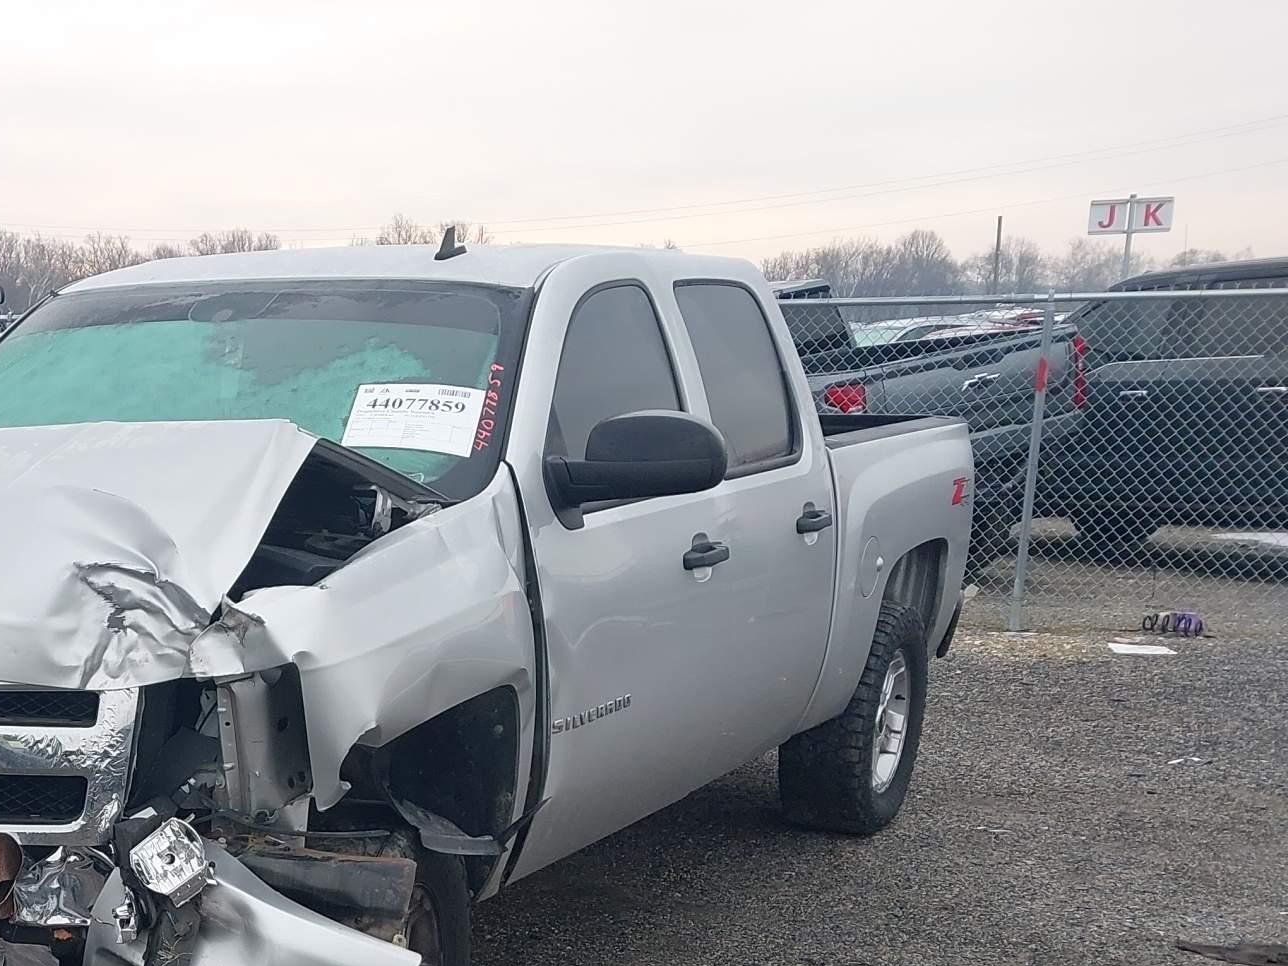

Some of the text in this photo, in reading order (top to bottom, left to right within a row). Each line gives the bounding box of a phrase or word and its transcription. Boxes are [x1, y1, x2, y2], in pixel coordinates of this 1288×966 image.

[1098, 203, 1165, 228] J K
[366, 397, 466, 413] 44077859
[474, 363, 505, 451] 44077859
[551, 693, 632, 735] SILVERADO
